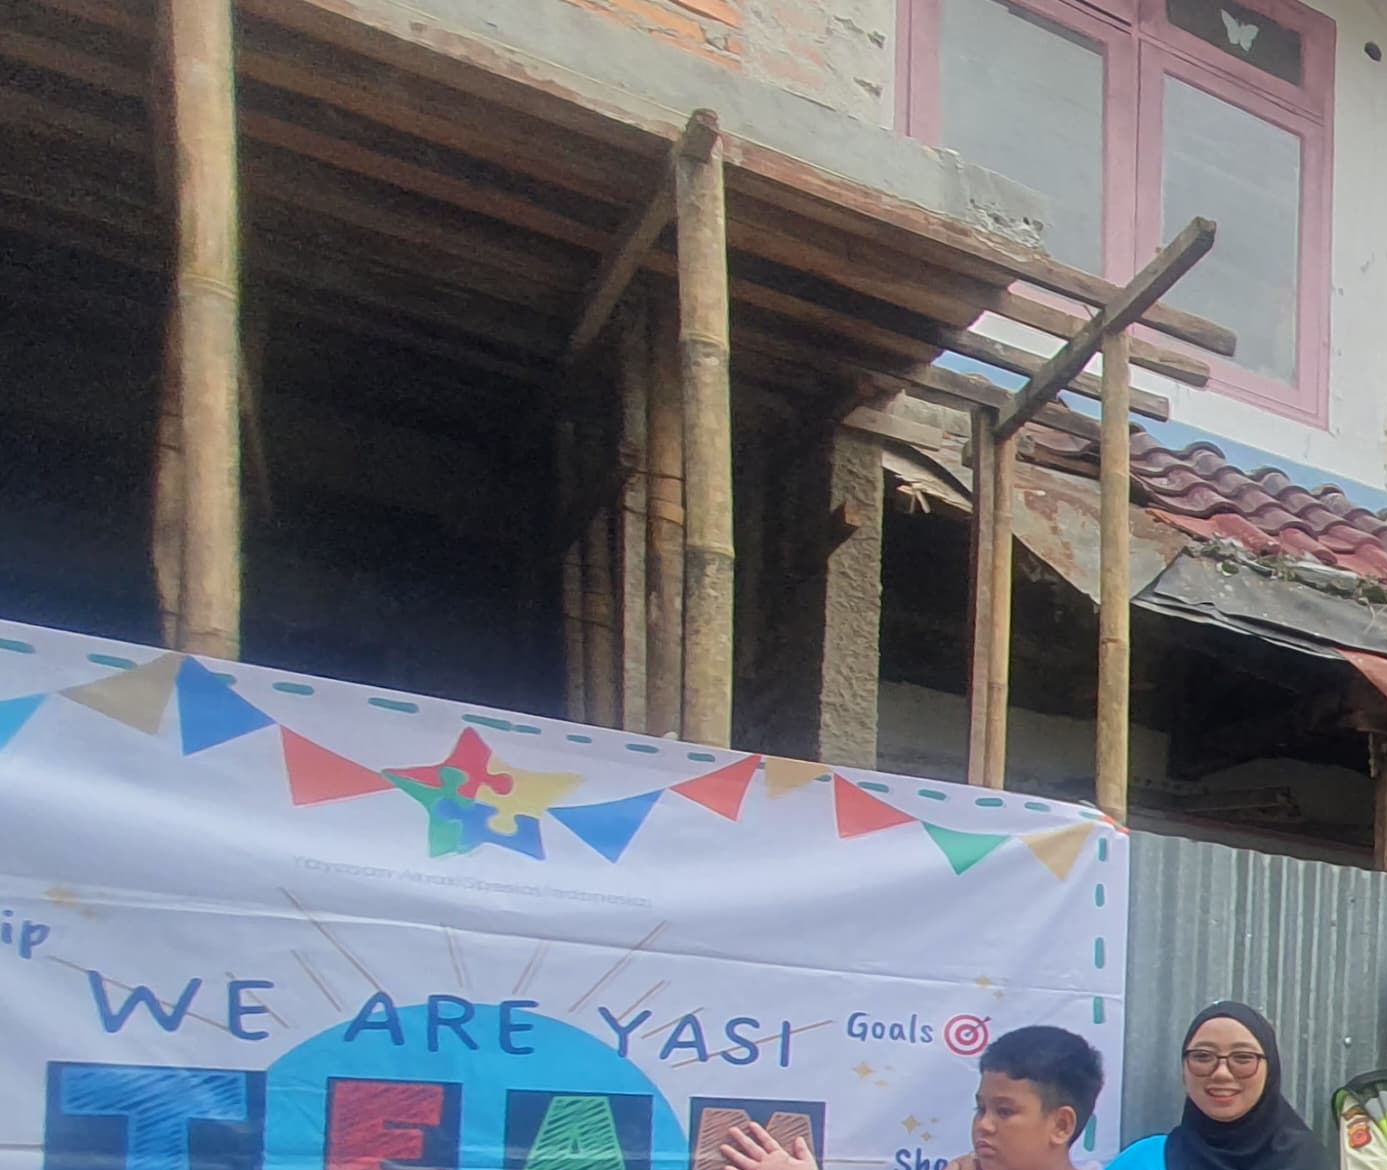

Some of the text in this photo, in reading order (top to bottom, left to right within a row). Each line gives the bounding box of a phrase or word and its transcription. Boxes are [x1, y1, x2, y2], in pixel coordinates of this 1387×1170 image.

[1, 910, 51, 960] ip
[87, 970, 791, 1068] WE ARE YASI
[847, 1012, 934, 1043] Goals
